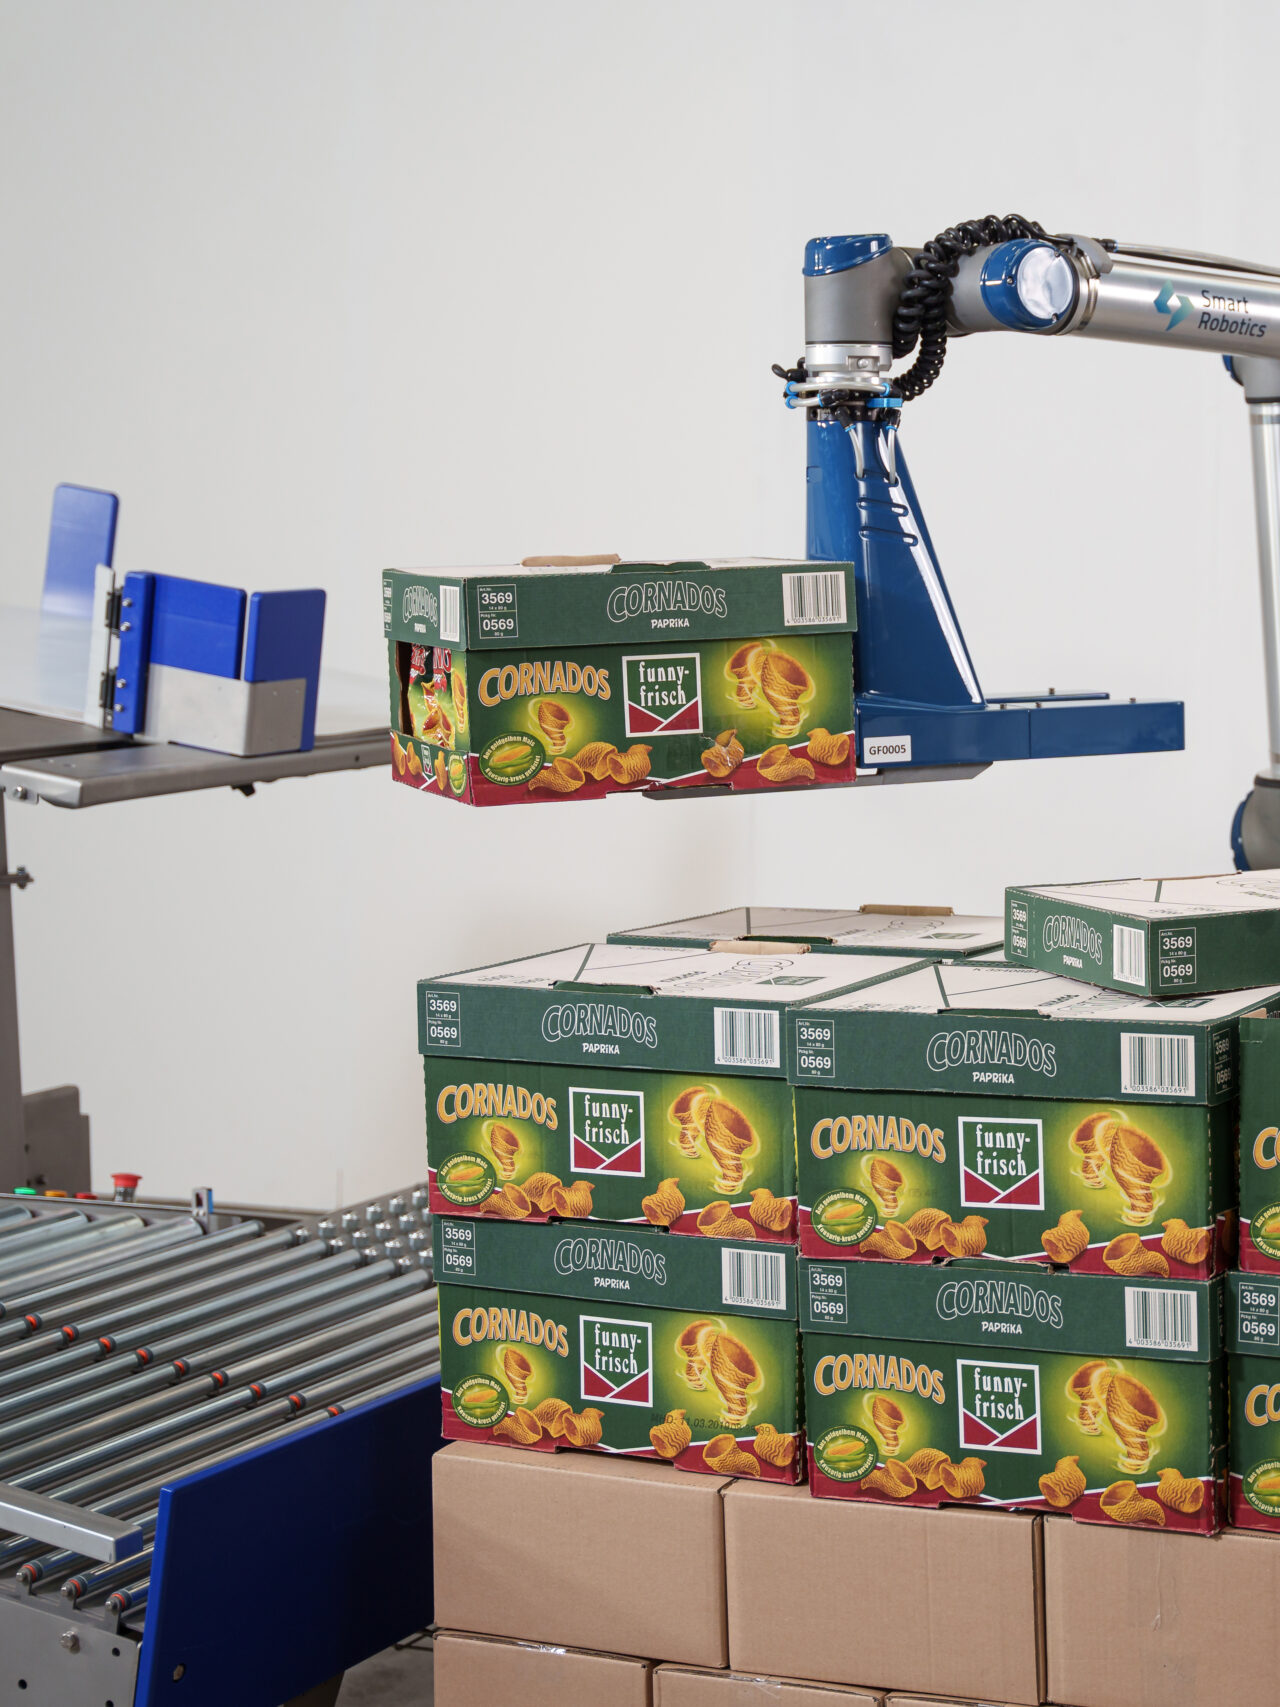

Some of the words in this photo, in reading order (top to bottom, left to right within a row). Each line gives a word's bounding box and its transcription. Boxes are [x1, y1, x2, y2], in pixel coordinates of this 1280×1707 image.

[1202, 289, 1249, 314] Smart
[1198, 312, 1267, 338] Robotics
[481, 592, 513, 604] 3569
[607, 581, 728, 623] CORNADOS
[483, 618, 514, 631] 0569
[478, 661, 611, 707] CORNADOS
[639, 661, 690, 686] funny-
[640, 684, 687, 707] frisch
[868, 744, 907, 756] GF0005
[1043, 915, 1102, 965] CORNADOS
[1163, 936, 1193, 949] 3569
[1163, 964, 1193, 977] 0569
[430, 999, 457, 1012] 3569
[430, 1026, 458, 1039] 0569
[541, 1004, 657, 1048] CORNADOS
[800, 1027, 831, 1040] 3569
[801, 1056, 831, 1069] 0569
[926, 1030, 1057, 1078] CORNADOS
[436, 1083, 558, 1130] CORNADOS
[584, 1094, 634, 1123] funny-
[584, 1119, 630, 1145] frisch
[810, 1115, 946, 1164] CORNADOS
[976, 1124, 1031, 1153] funny-
[976, 1151, 1027, 1176] frisch
[445, 1227, 472, 1241] 3569
[446, 1254, 472, 1267] 0569
[554, 1238, 667, 1286] CORNADOS
[812, 1273, 843, 1287] 3569
[813, 1301, 844, 1315] 0569
[936, 1280, 1063, 1329] CORNADOS
[1243, 1292, 1275, 1306] 3569
[452, 1307, 569, 1357] CORNADOS
[594, 1323, 642, 1353] funny-
[1242, 1321, 1275, 1336] 0569
[594, 1348, 639, 1375] frisch
[814, 1353, 945, 1404] CORNADOS
[974, 1367, 1028, 1397] funny-
[974, 1394, 1024, 1420] frisch
